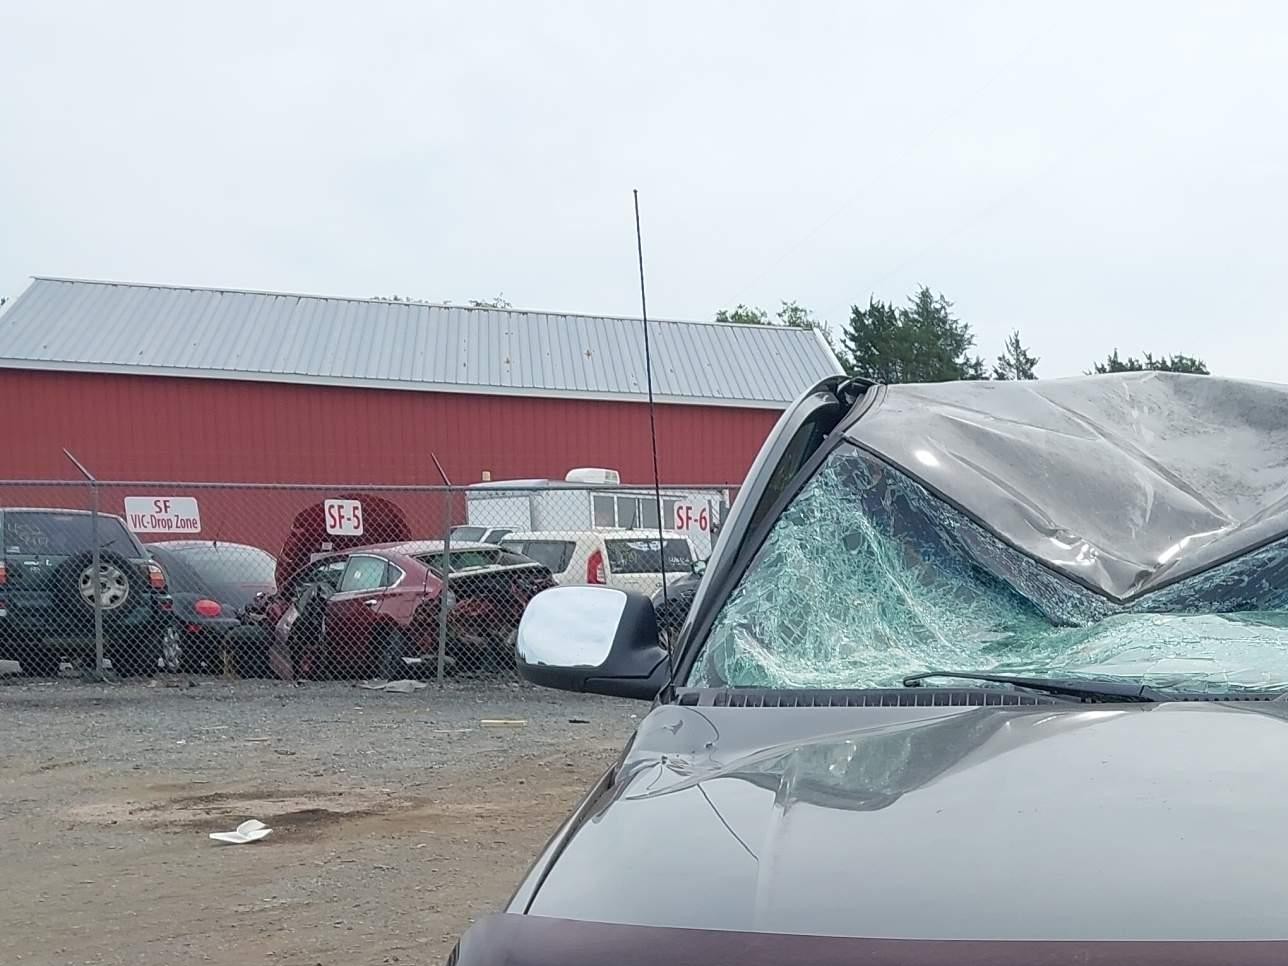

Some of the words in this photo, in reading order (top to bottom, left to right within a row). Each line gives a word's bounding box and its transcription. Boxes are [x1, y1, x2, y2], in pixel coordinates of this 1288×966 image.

[153, 499, 171, 514] SF
[327, 504, 361, 530] SF-5
[130, 514, 173, 531] VIC-Drop
[174, 514, 198, 529] Zone
[676, 505, 708, 531] SF-6
